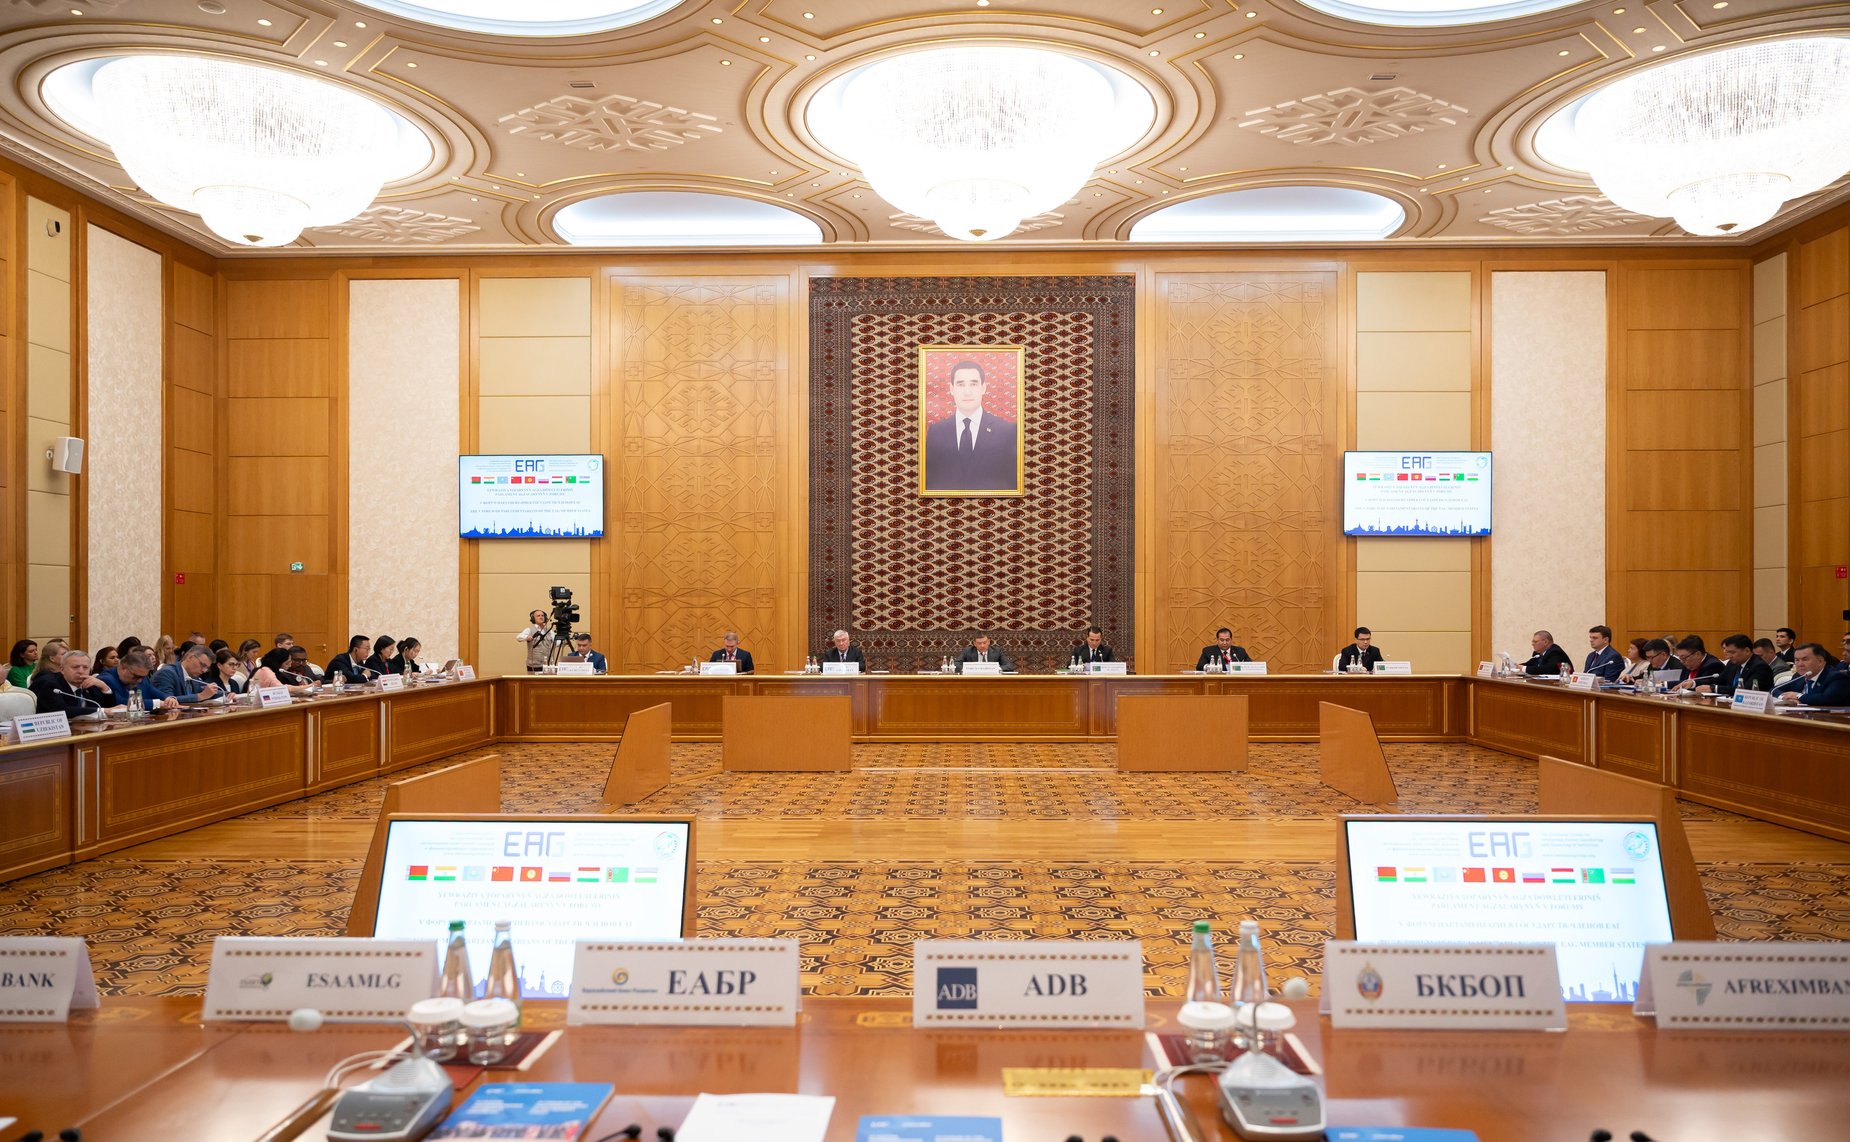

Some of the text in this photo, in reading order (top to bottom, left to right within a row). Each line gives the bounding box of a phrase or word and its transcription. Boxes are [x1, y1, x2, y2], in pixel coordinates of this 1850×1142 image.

[515, 459, 545, 473] EAG
[1401, 456, 1432, 470] EAG
[503, 831, 566, 858] EAG
[1468, 831, 1532, 858] EAG
[306, 973, 402, 989] ESAAMLG
[667, 970, 757, 995] ЕАБР
[938, 983, 977, 1000] ADB
[1023, 973, 1088, 996] ADB
[1415, 974, 1527, 998] БКБОП
